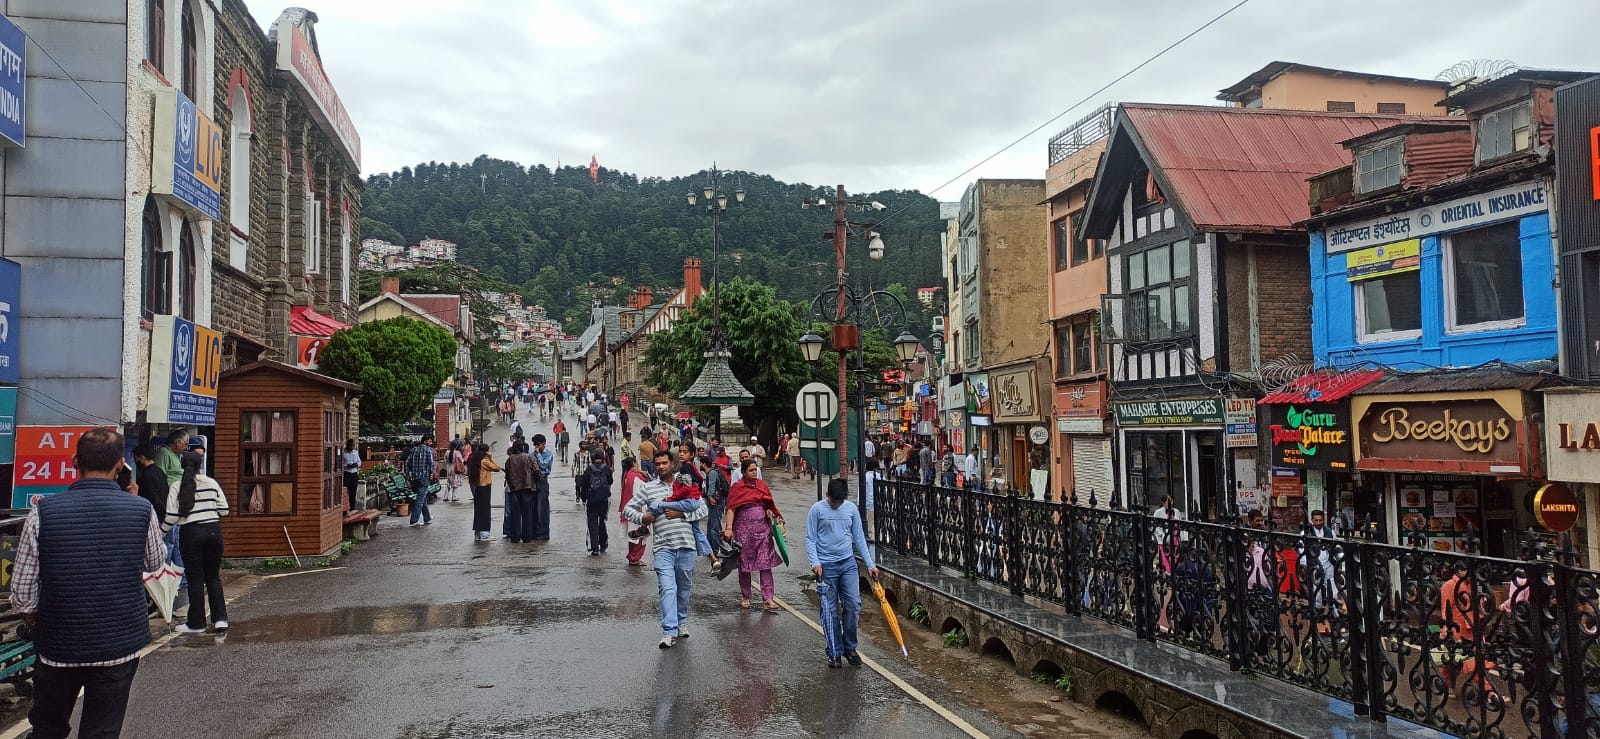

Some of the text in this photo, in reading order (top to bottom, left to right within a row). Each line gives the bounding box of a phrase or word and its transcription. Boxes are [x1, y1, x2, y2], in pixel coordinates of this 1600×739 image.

[0, 41, 21, 84] गम
[196, 116, 221, 184] LIC
[1441, 187, 1545, 224] ORIENTAL INSURANCE
[193, 330, 219, 390] LIC
[1120, 399, 1217, 417] MAHASHE ENTERPRISES
[1227, 399, 1255, 412] LED TV
[1302, 408, 1334, 427] Guru
[38, 432, 86, 449] AT
[1299, 425, 1344, 448] Palace
[1372, 407, 1511, 454] Beekays
[21, 461, 51, 480] 24
[1541, 503, 1576, 513] LAKSHITA
